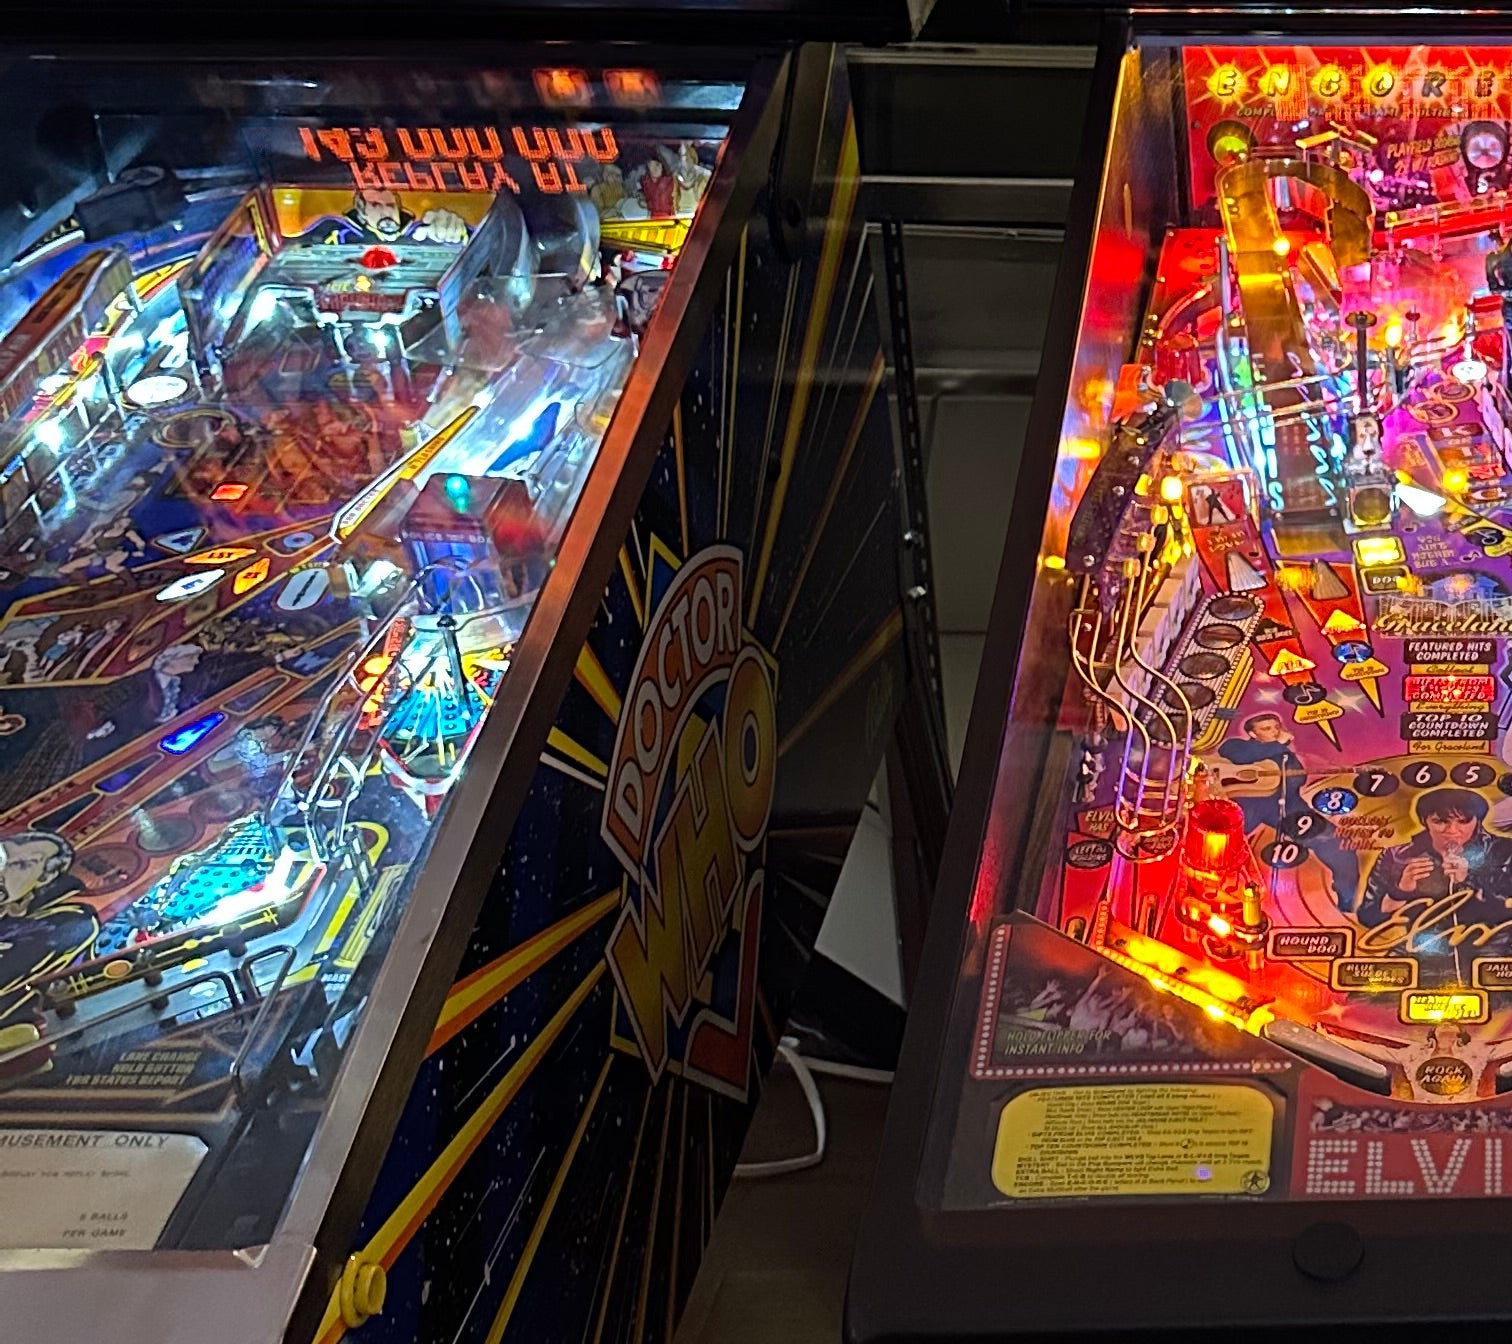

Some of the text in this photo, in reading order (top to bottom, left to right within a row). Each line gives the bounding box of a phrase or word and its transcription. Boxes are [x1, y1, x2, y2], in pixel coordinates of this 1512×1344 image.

[1408, 641, 1492, 652] FEATURED HITS
[1416, 651, 1479, 661] COMPLETED
[611, 571, 738, 843] DOCTOR
[1416, 714, 1483, 722] TOP 10
[1408, 722, 1489, 730] COUNTDOWN
[1412, 729, 1485, 738] COMPLETED
[1371, 774, 1385, 792] 7
[1416, 766, 1431, 784] 6
[1465, 766, 1480, 784] 5
[1328, 791, 1343, 810] 8
[1085, 810, 1114, 822] ELVIS
[1089, 822, 1109, 832] HAS
[1297, 815, 1313, 835] 9
[1271, 844, 1298, 864] 10
[606, 647, 778, 1086] WHO
[1280, 936, 1329, 946] HOUND
[1307, 945, 1337, 953] DOG
[1485, 964, 1509, 972] JAIL
[1088, 1030, 1111, 1040] FOR
[1005, 1043, 1085, 1055] INSTANT INFO
[1423, 1064, 1465, 1074] ROCK
[1420, 1074, 1467, 1084] AGAIN
[115, 1134, 170, 1148] ONLY
